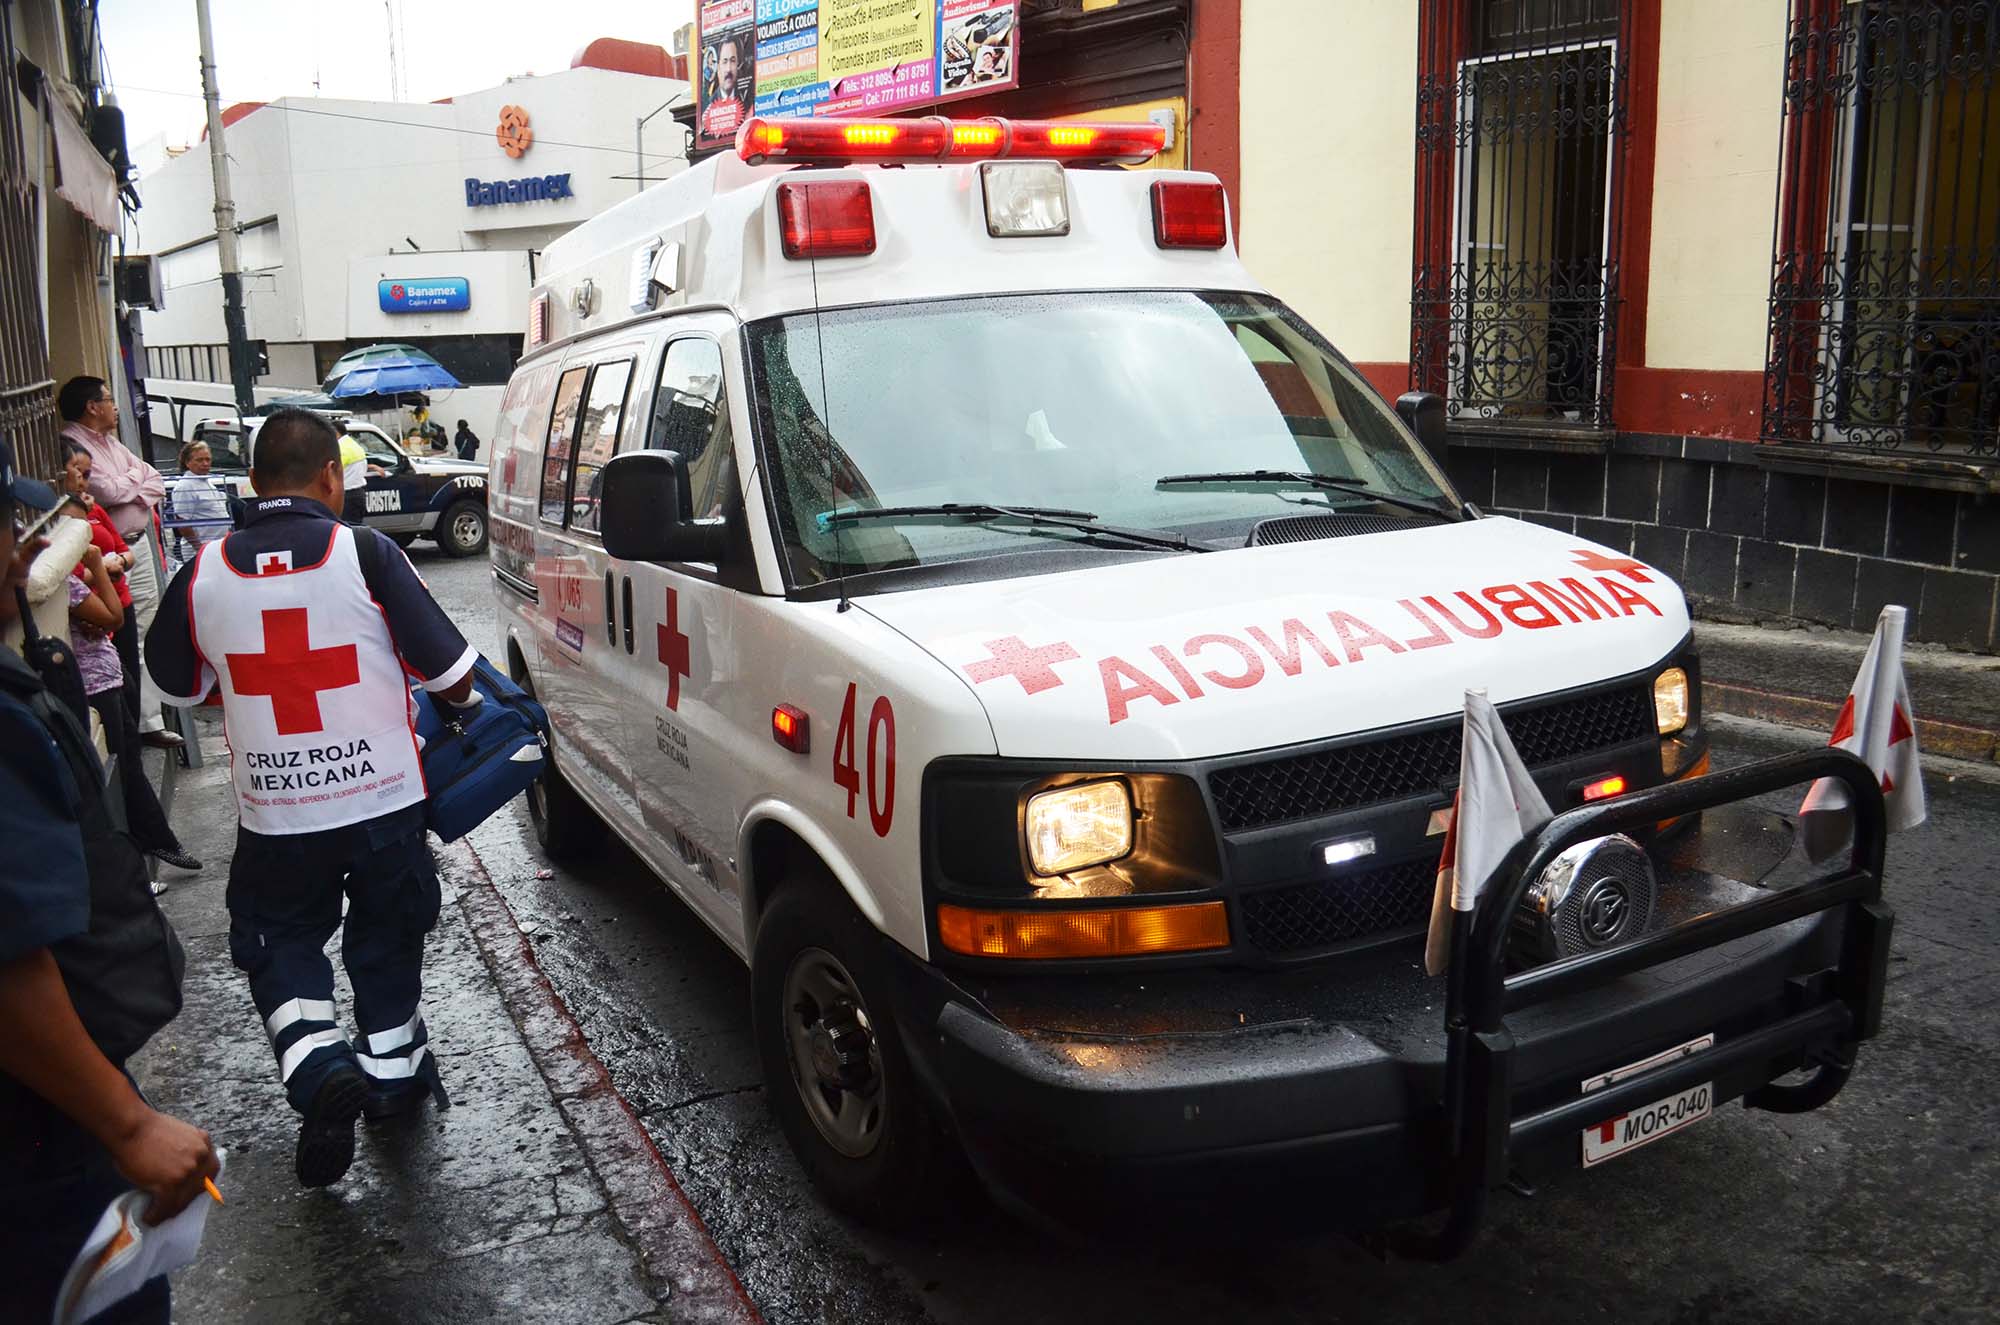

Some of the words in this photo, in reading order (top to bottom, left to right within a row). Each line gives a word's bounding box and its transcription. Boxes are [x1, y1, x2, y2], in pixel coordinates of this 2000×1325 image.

[757, 4, 773, 19] DE
[757, 21, 789, 40] VOLANTES
[788, 18, 795, 31] A
[795, 12, 817, 29] COLOR
[832, 15, 857, 31] Recibos
[858, 9, 867, 24] de
[867, 0, 916, 21] Arrendamiento
[832, 31, 869, 52] Invitaciones
[832, 51, 865, 71] Comandas
[865, 49, 880, 68] para
[881, 38, 923, 60] restaurantes
[842, 79, 859, 93] Tels:
[861, 75, 873, 90] 312
[896, 68, 909, 81] 261
[911, 63, 929, 79] 8791
[865, 91, 880, 106] Cel:
[881, 88, 894, 102] 777
[896, 86, 908, 99] 111
[909, 84, 918, 98] 81
[920, 81, 930, 95] 45
[465, 173, 574, 207] Banamex
[407, 287, 457, 297] Banamex
[454, 475, 484, 488] 1700
[258, 498, 292, 511] FRANCES
[365, 490, 401, 512] URISTICA
[655, 715, 672, 740] CRUZ
[671, 725, 688, 749] ROJA
[246, 751, 303, 769] CRUZ
[308, 738, 372, 765] ROJA
[656, 734, 690, 772] MEXICANA
[832, 682, 896, 838] 40
[250, 760, 376, 791] MEXICANA
[1623, 1088, 1708, 1143] MOR-040
